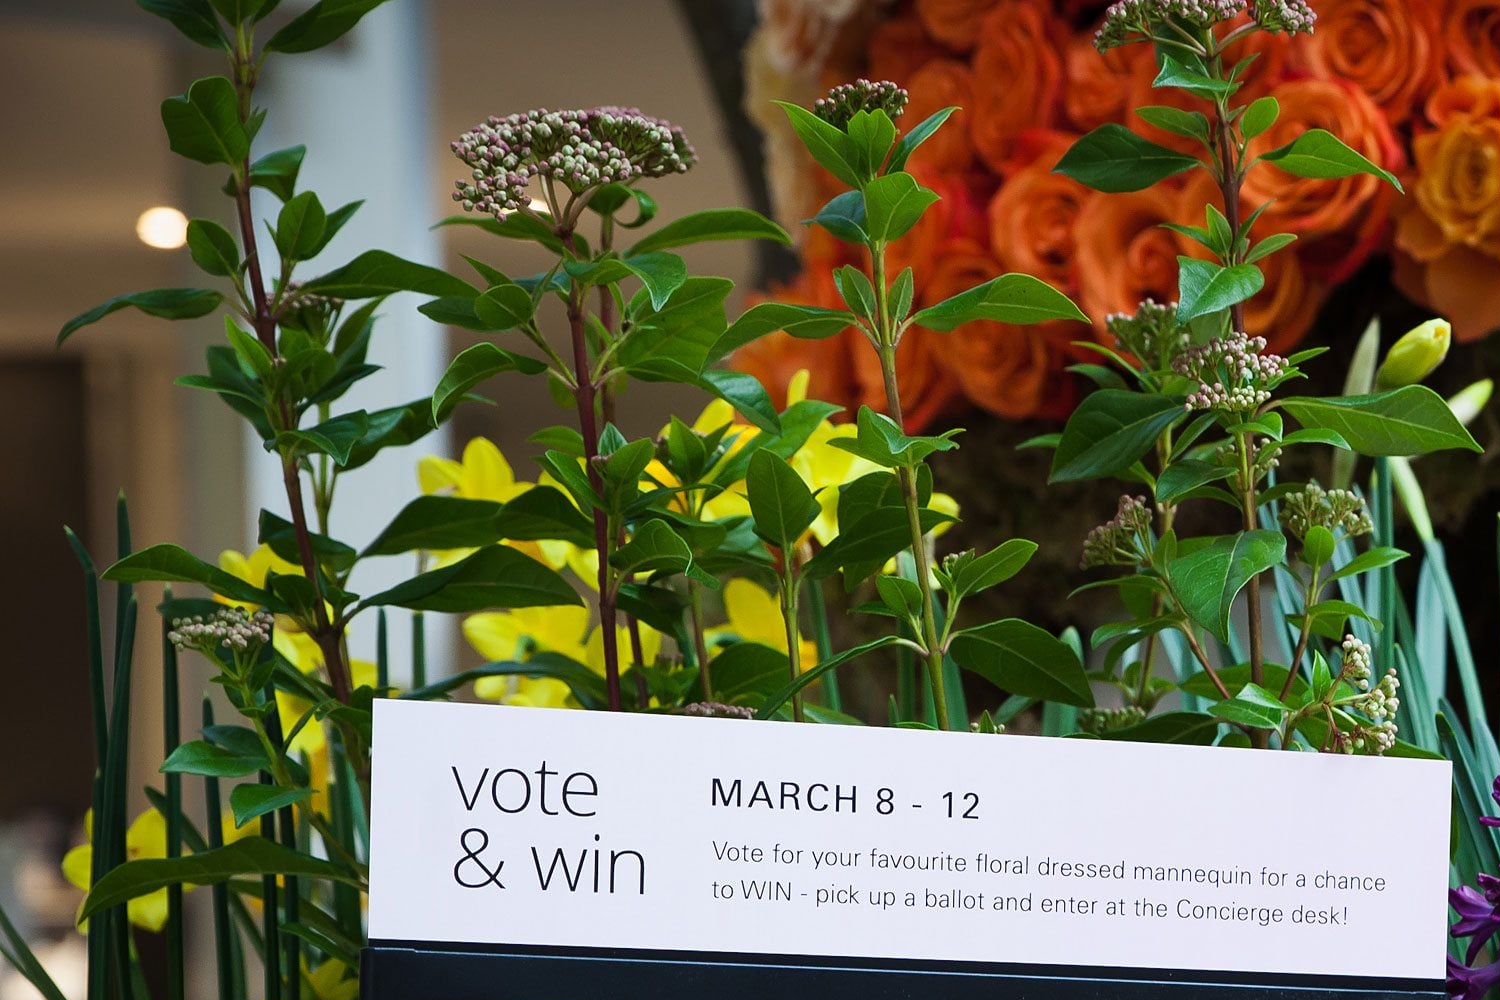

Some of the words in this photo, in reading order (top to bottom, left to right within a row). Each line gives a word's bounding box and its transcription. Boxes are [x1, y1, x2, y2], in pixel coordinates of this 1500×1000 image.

[451, 760, 598, 817] vote
[712, 778, 856, 813] MARCH
[876, 788, 894, 815] 8
[942, 792, 979, 819] 12
[454, 828, 506, 889] &
[531, 834, 645, 895] win
[712, 840, 763, 863] Vote
[772, 843, 804, 864] for
[812, 851, 861, 870] your
[870, 848, 967, 872] favourite
[976, 853, 1029, 874] floral
[1038, 856, 1125, 879] dressed
[1134, 865, 1251, 888] mannequin
[1260, 866, 1288, 886] for
[1295, 874, 1306, 888] a
[1314, 870, 1386, 891] chance
[712, 881, 734, 899] to
[741, 880, 791, 901] WIN
[816, 884, 859, 908] pick
[869, 891, 896, 910] up
[904, 892, 915, 907] a
[925, 888, 984, 910] ballot
[993, 892, 1032, 912] and
[1041, 897, 1098, 914] enter
[1106, 899, 1125, 916] at
[1134, 897, 1167, 918] the
[1177, 899, 1283, 926] Concierge
[1292, 904, 1347, 925] desk!
